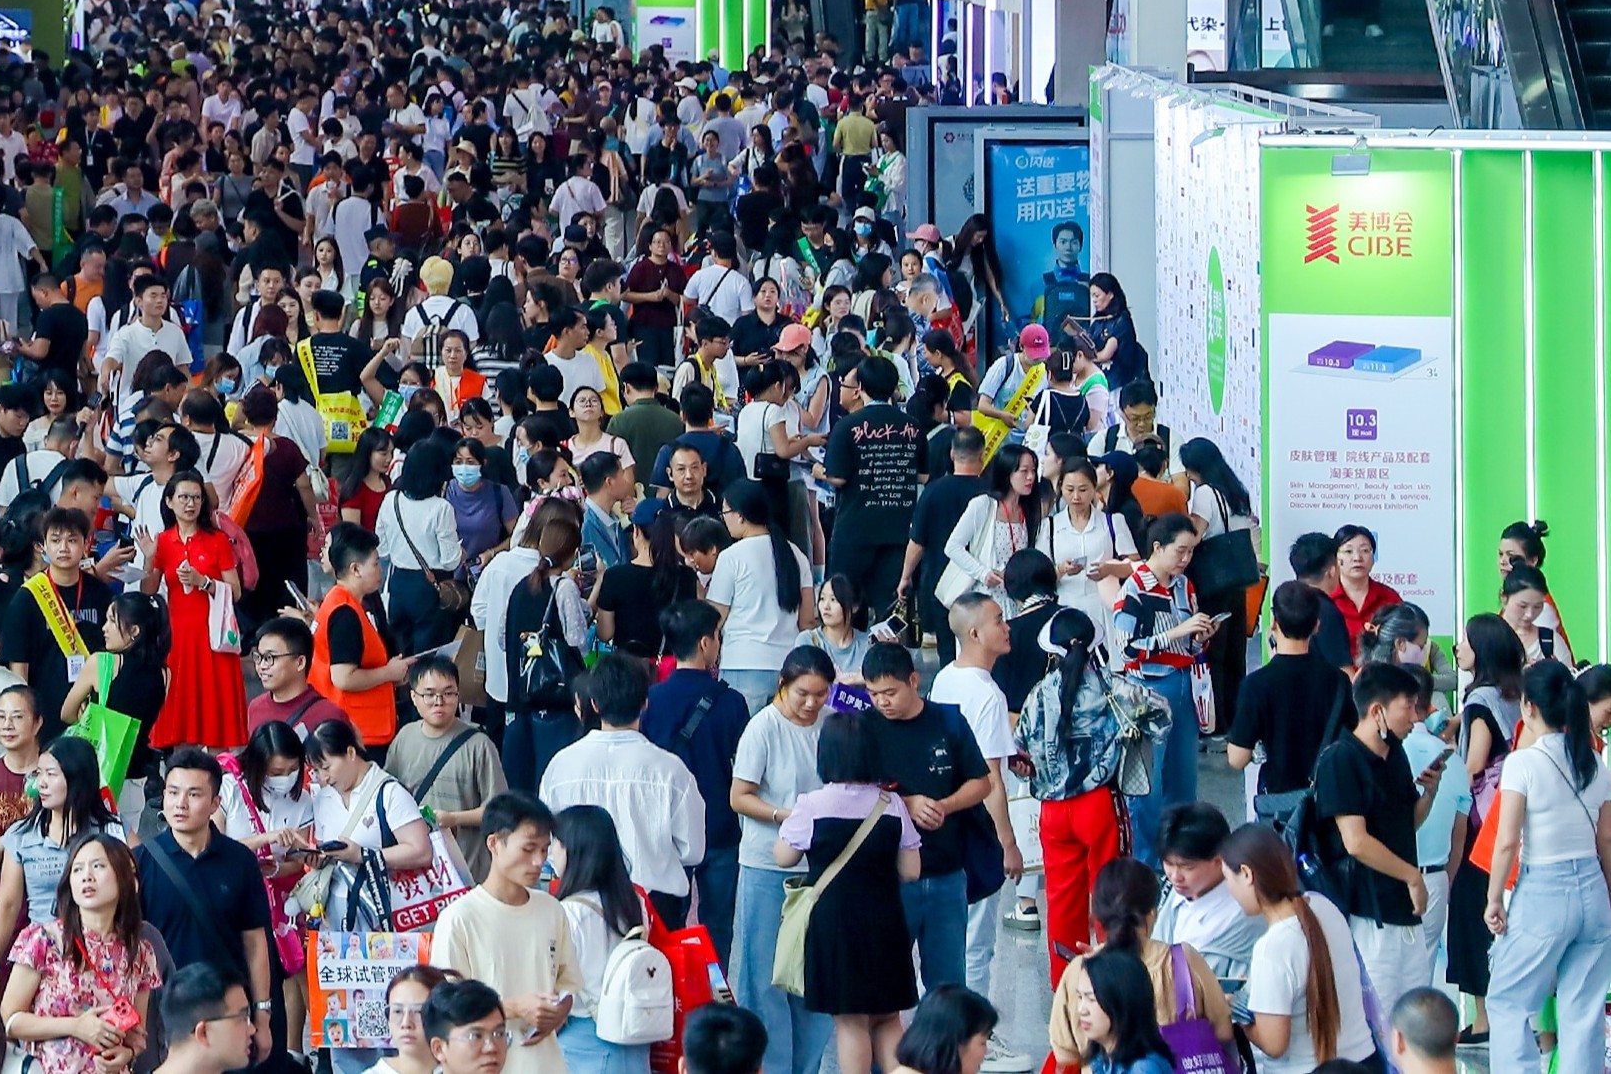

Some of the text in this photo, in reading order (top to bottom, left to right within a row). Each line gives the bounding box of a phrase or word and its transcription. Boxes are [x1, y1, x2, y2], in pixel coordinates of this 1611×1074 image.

[1017, 198, 1075, 223] 用闪送
[1348, 212, 1413, 232] 美博会
[1348, 237, 1413, 257] CIBE
[1349, 414, 1377, 426] 10.3
[1290, 450, 1430, 463] 皮肤管理 院线产品及配套
[397, 906, 430, 927] GET
